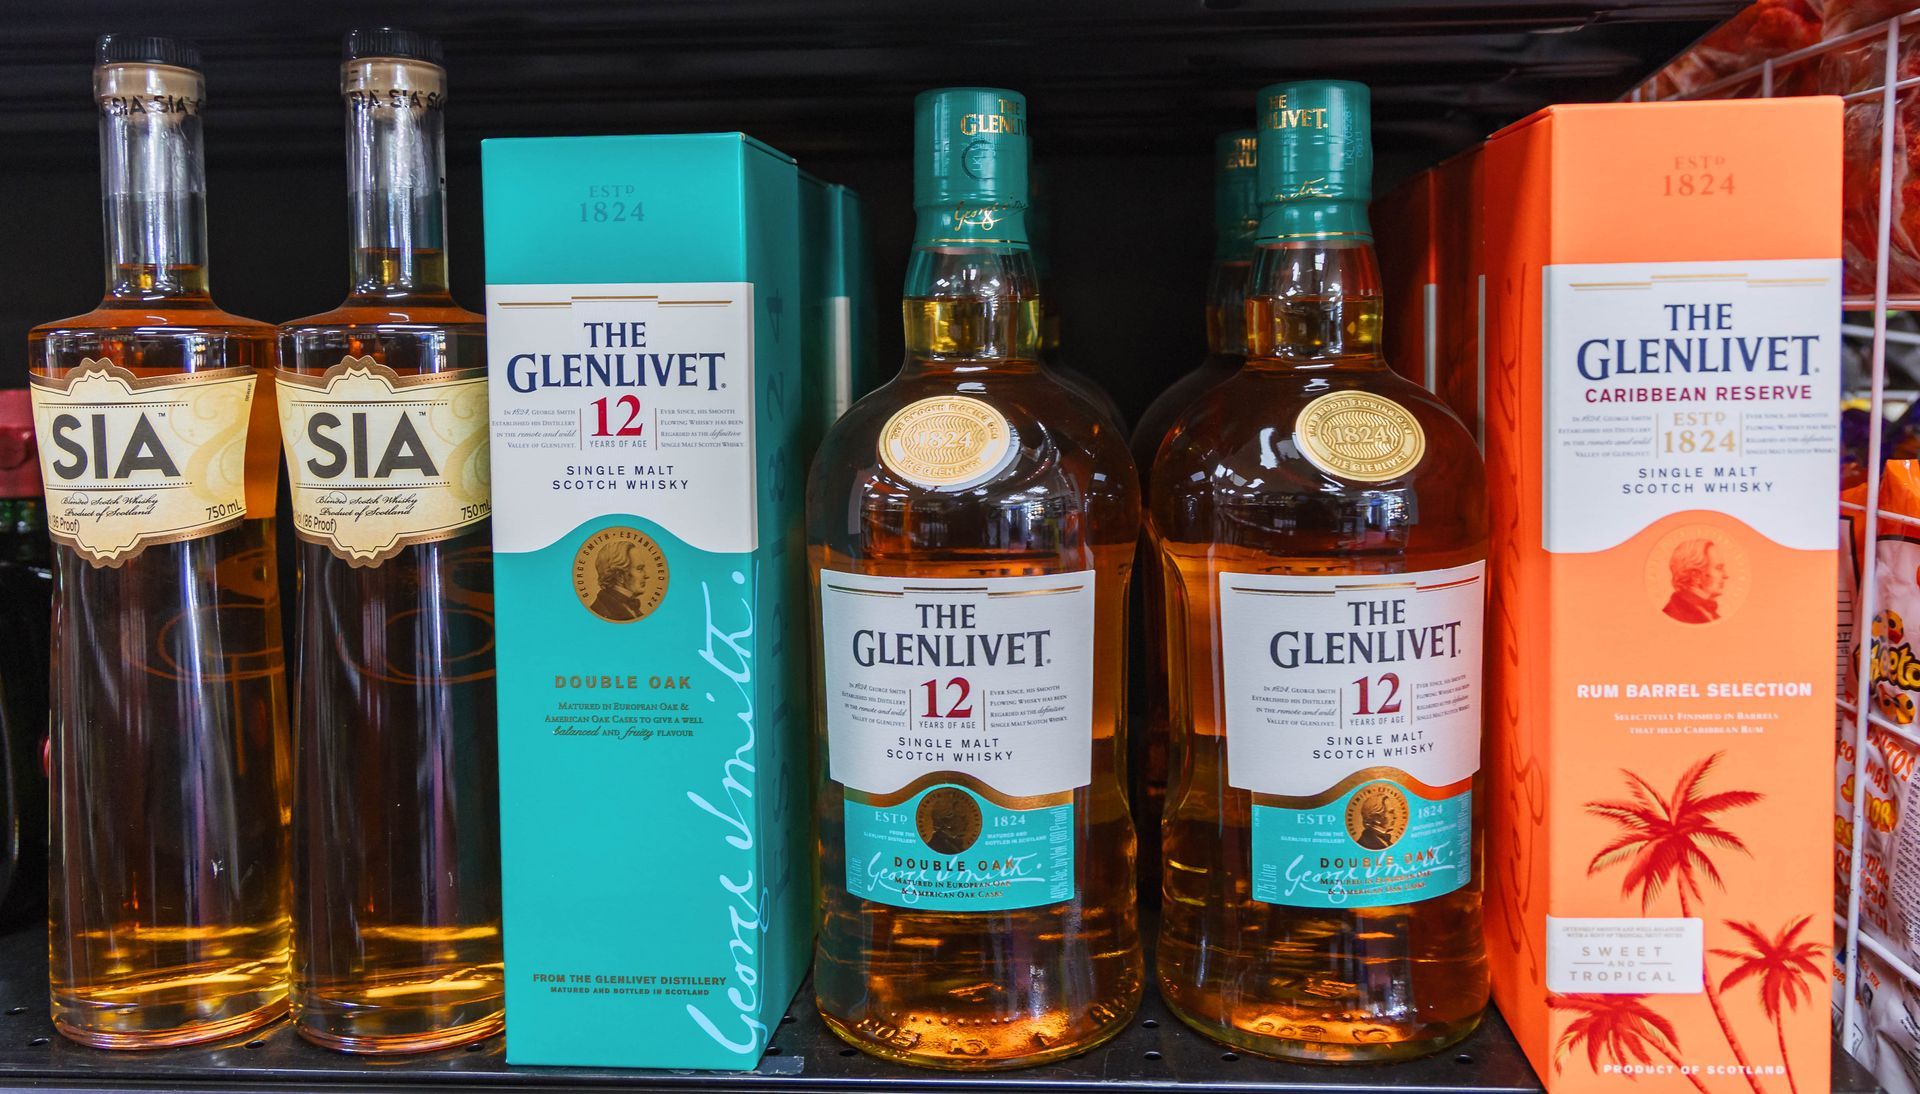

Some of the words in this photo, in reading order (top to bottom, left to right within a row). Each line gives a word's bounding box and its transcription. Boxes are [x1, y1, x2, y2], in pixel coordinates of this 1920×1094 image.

[154, 95, 187, 113] SIA
[998, 99, 1020, 115] THE
[589, 184, 635, 198] ESTD
[1664, 173, 1735, 197] 1824
[580, 201, 645, 223] 1824
[1664, 303, 1732, 331] THE
[584, 322, 646, 348] THE
[1577, 335, 1820, 381] GLENLIVET
[507, 352, 726, 393] GLENLIVET
[1585, 387, 1706, 403] CARIBBEAN
[1717, 385, 1812, 401] RESERVE
[590, 394, 643, 437] 12
[1673, 411, 1726, 427] ESTD
[914, 431, 971, 449] 1824
[1333, 426, 1389, 444] 1824
[1664, 429, 1735, 454] 1824
[52, 411, 181, 480] SIA
[307, 411, 439, 478] SIA
[590, 440, 615, 448] YEARS
[566, 465, 625, 475] SINGLE
[634, 465, 674, 475] MALT
[1350, 452, 1408, 473] GLENLIVET
[1639, 467, 1703, 478] SINGLE
[1714, 466, 1757, 477] MALT
[552, 480, 617, 489] SCOTCH
[626, 480, 689, 489] WHISKY
[1622, 483, 1693, 494] SCOTCH
[1704, 482, 1773, 493] WHISKY
[61, 492, 89, 505] Blended
[91, 495, 119, 505] Scotch
[122, 494, 158, 509] Whisky
[316, 491, 347, 505] Blended
[350, 495, 379, 505] Scotch
[382, 493, 418, 508] Whisky
[65, 508, 94, 516] Product
[95, 509, 106, 522] of
[106, 506, 154, 517] Scotland
[206, 505, 226, 520] 750
[228, 499, 242, 512] mL
[319, 507, 352, 516] Product
[355, 508, 365, 522] of
[365, 506, 414, 516] Scotland
[461, 504, 478, 520] 750
[303, 517, 313, 529] (86
[314, 517, 337, 533] Proof)
[577, 560, 588, 598] GEORGE
[583, 533, 610, 556] SMITH
[620, 531, 665, 581] ESTABLISHED
[915, 604, 976, 629] THE
[1347, 599, 1406, 626] THE
[853, 629, 1051, 667] GLENLIVET
[1269, 620, 1462, 669] GLENLIVET
[555, 676, 638, 689] DOUBLE
[649, 676, 691, 689] OAK
[1577, 684, 1618, 698] RUM
[1626, 683, 1700, 698] BARREL
[1707, 683, 1812, 698] SELECTION
[920, 676, 973, 718] 12
[1352, 673, 1402, 715] 12
[558, 702, 600, 711] MATURED
[602, 703, 611, 711] IN
[613, 703, 658, 711] EUROPEAN
[659, 703, 678, 711] OAK
[680, 703, 688, 711] &
[545, 715, 589, 723] AMERICAN
[591, 715, 610, 723] OAK
[612, 715, 638, 724] CASKS
[1350, 718, 1375, 726] YEARS
[1378, 717, 1387, 725] OF
[1391, 716, 1404, 724] AGE
[1614, 712, 1675, 721] SELECTIVELY
[1677, 712, 1722, 721] FINISHED
[1724, 712, 1734, 721] IN
[1737, 711, 1779, 720] BARRELS
[552, 725, 601, 737] balanced
[602, 729, 620, 737] AND
[618, 725, 654, 741] fruity
[657, 729, 694, 737] FLAVOUR
[919, 721, 944, 729] YEARS
[948, 721, 957, 729] OF
[961, 721, 975, 729] AGE
[1629, 726, 1655, 734] THAT
[1657, 726, 1681, 734] HELD
[1684, 725, 1738, 734] CARIBBEAN
[1741, 725, 1764, 734] RUM
[899, 737, 952, 749] SINGLE
[961, 737, 999, 748] MALT
[1327, 735, 1383, 746] SINGLE
[1391, 731, 1423, 743] MALT
[887, 749, 944, 762] SCOTCH
[954, 751, 1013, 762] WHISKY
[1313, 749, 1375, 759] SCOTCH
[1384, 743, 1434, 757] WHISKY
[1418, 804, 1442, 819] 1824
[994, 814, 1025, 827] 1824
[894, 857, 966, 872] DOUBLE
[978, 857, 1015, 871] OAK
[1320, 856, 1394, 869] DOUBLE
[1404, 848, 1434, 864] OAK
[894, 876, 933, 887] MATURED
[935, 880, 944, 888] IN
[946, 880, 990, 889] EUROPEAN
[912, 889, 955, 898] AMERICAN
[957, 890, 975, 899] OAK
[978, 890, 1004, 898] CASKS
[1582, 946, 1662, 957] SWEET
[533, 973, 565, 983] FROM
[570, 975, 591, 984] THE
[595, 975, 656, 985] GLENLIVET
[661, 976, 726, 986] DISTILLERY
[1569, 971, 1676, 982] TROPICAL
[1603, 1064, 1673, 1075] PRODUCT
[1681, 1065, 1699, 1075] OF
[1707, 1065, 1785, 1075] SCOTLAND
